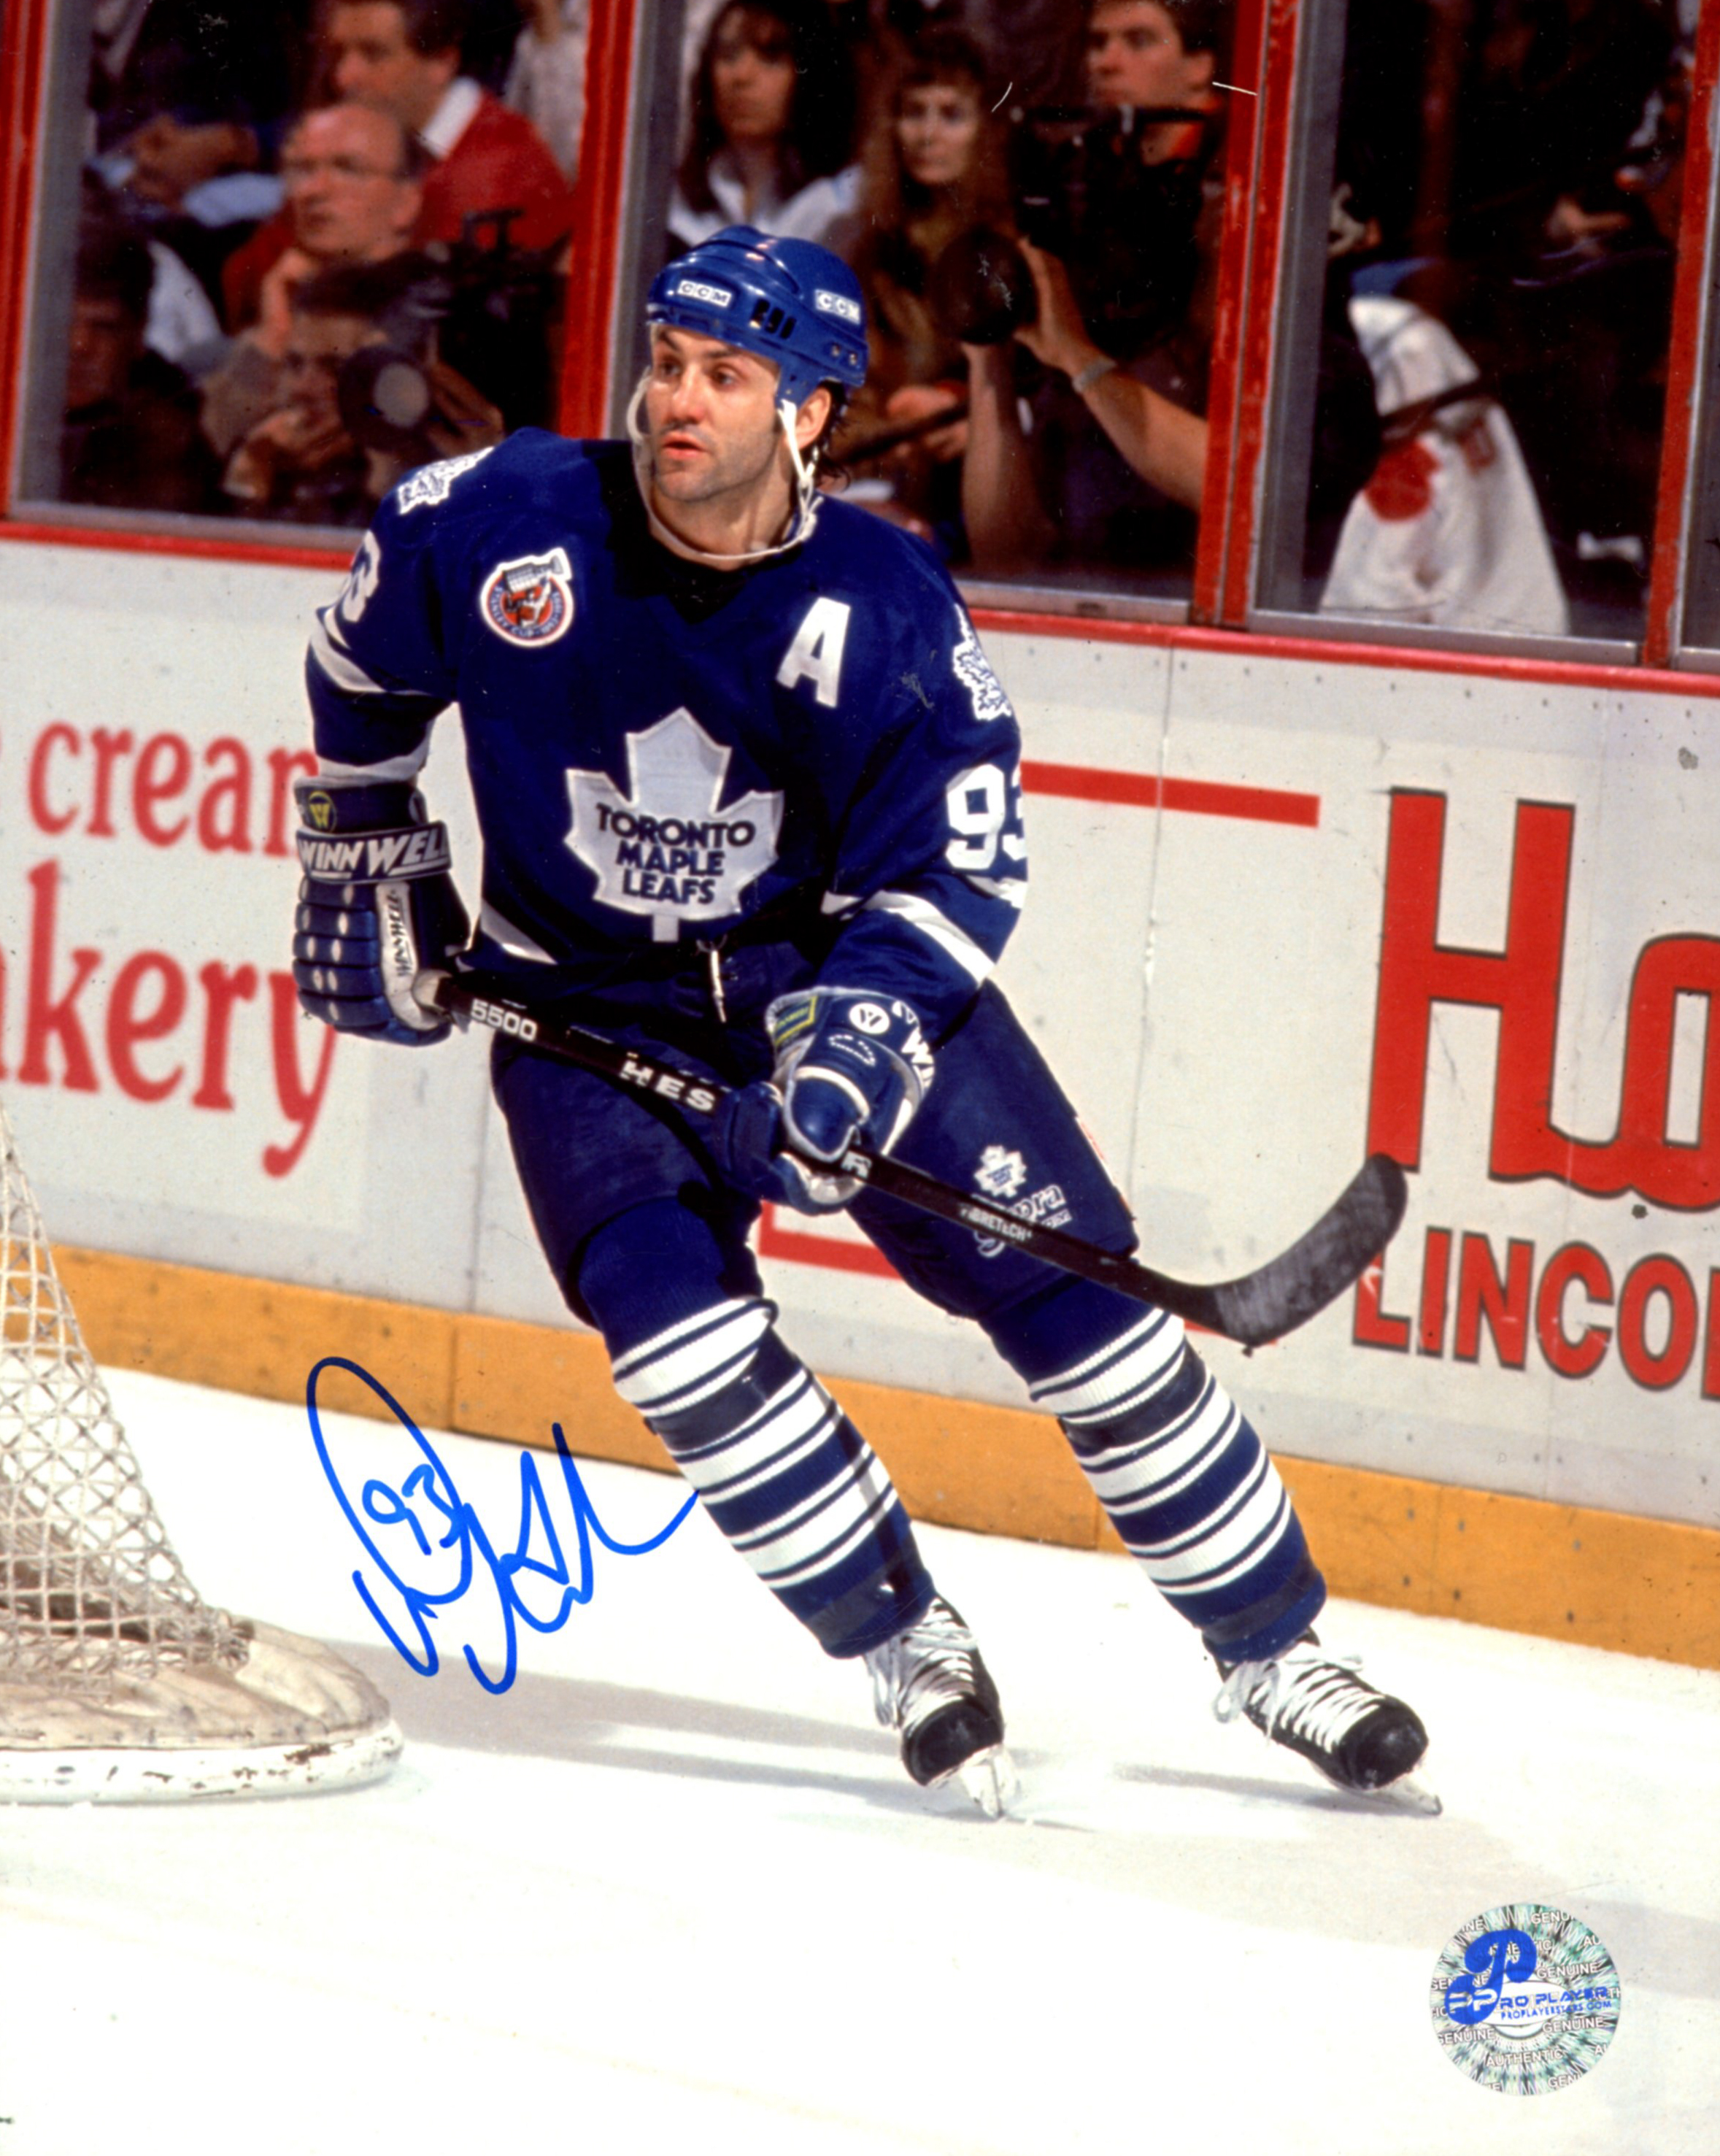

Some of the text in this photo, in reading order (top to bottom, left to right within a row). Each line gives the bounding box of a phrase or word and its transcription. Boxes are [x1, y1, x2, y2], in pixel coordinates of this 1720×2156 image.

[680, 282, 729, 305] CCM
[775, 597, 850, 709] A
[595, 802, 756, 847] TORONTO
[616, 840, 725, 876] MAPLE
[622, 869, 715, 904] LEAFS
[0, 857, 339, 1178] kery
[471, 998, 538, 1042] 5500
[1536, 1962, 1599, 1979] GENUINE
[1535, 1986, 1607, 2005] PLAYER
[1438, 2028, 1496, 2045] GENUINE
[1542, 2017, 1604, 2033] GENUINE
[1486, 2048, 1564, 2067] AUTHENTIC
